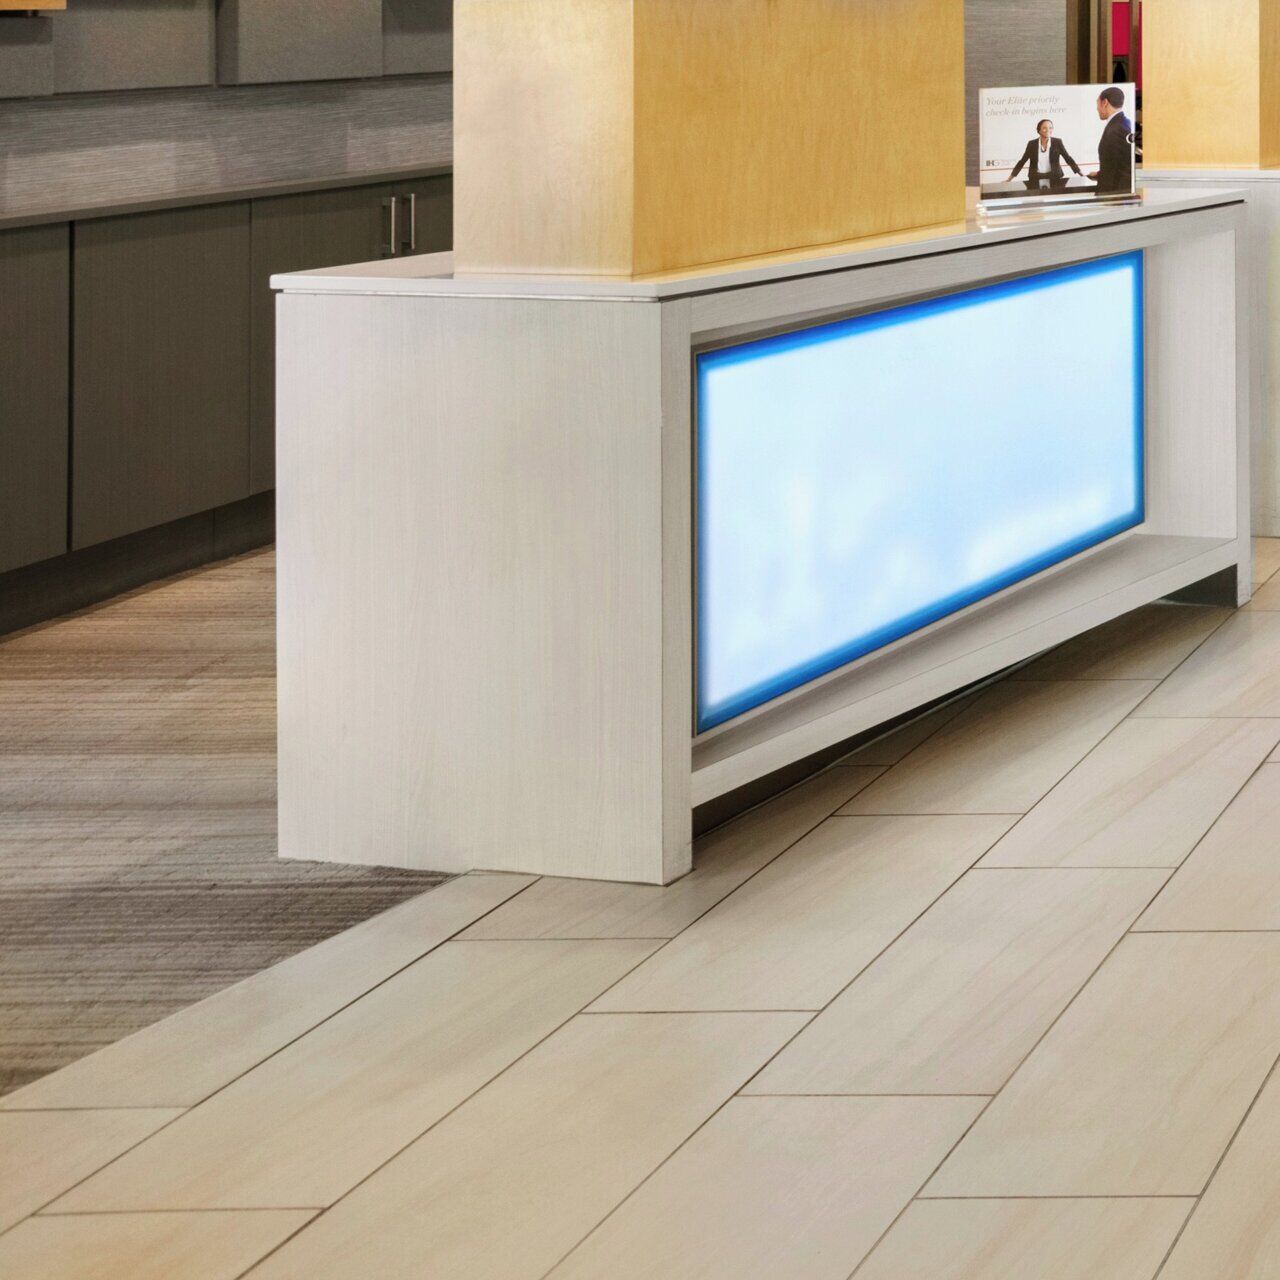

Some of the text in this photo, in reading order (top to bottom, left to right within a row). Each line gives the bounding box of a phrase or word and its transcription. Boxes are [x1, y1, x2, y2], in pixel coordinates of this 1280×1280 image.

[986, 95, 1060, 106] Your Elite priority
[1021, 106, 1048, 116] begins
[1049, 105, 1067, 113] here
